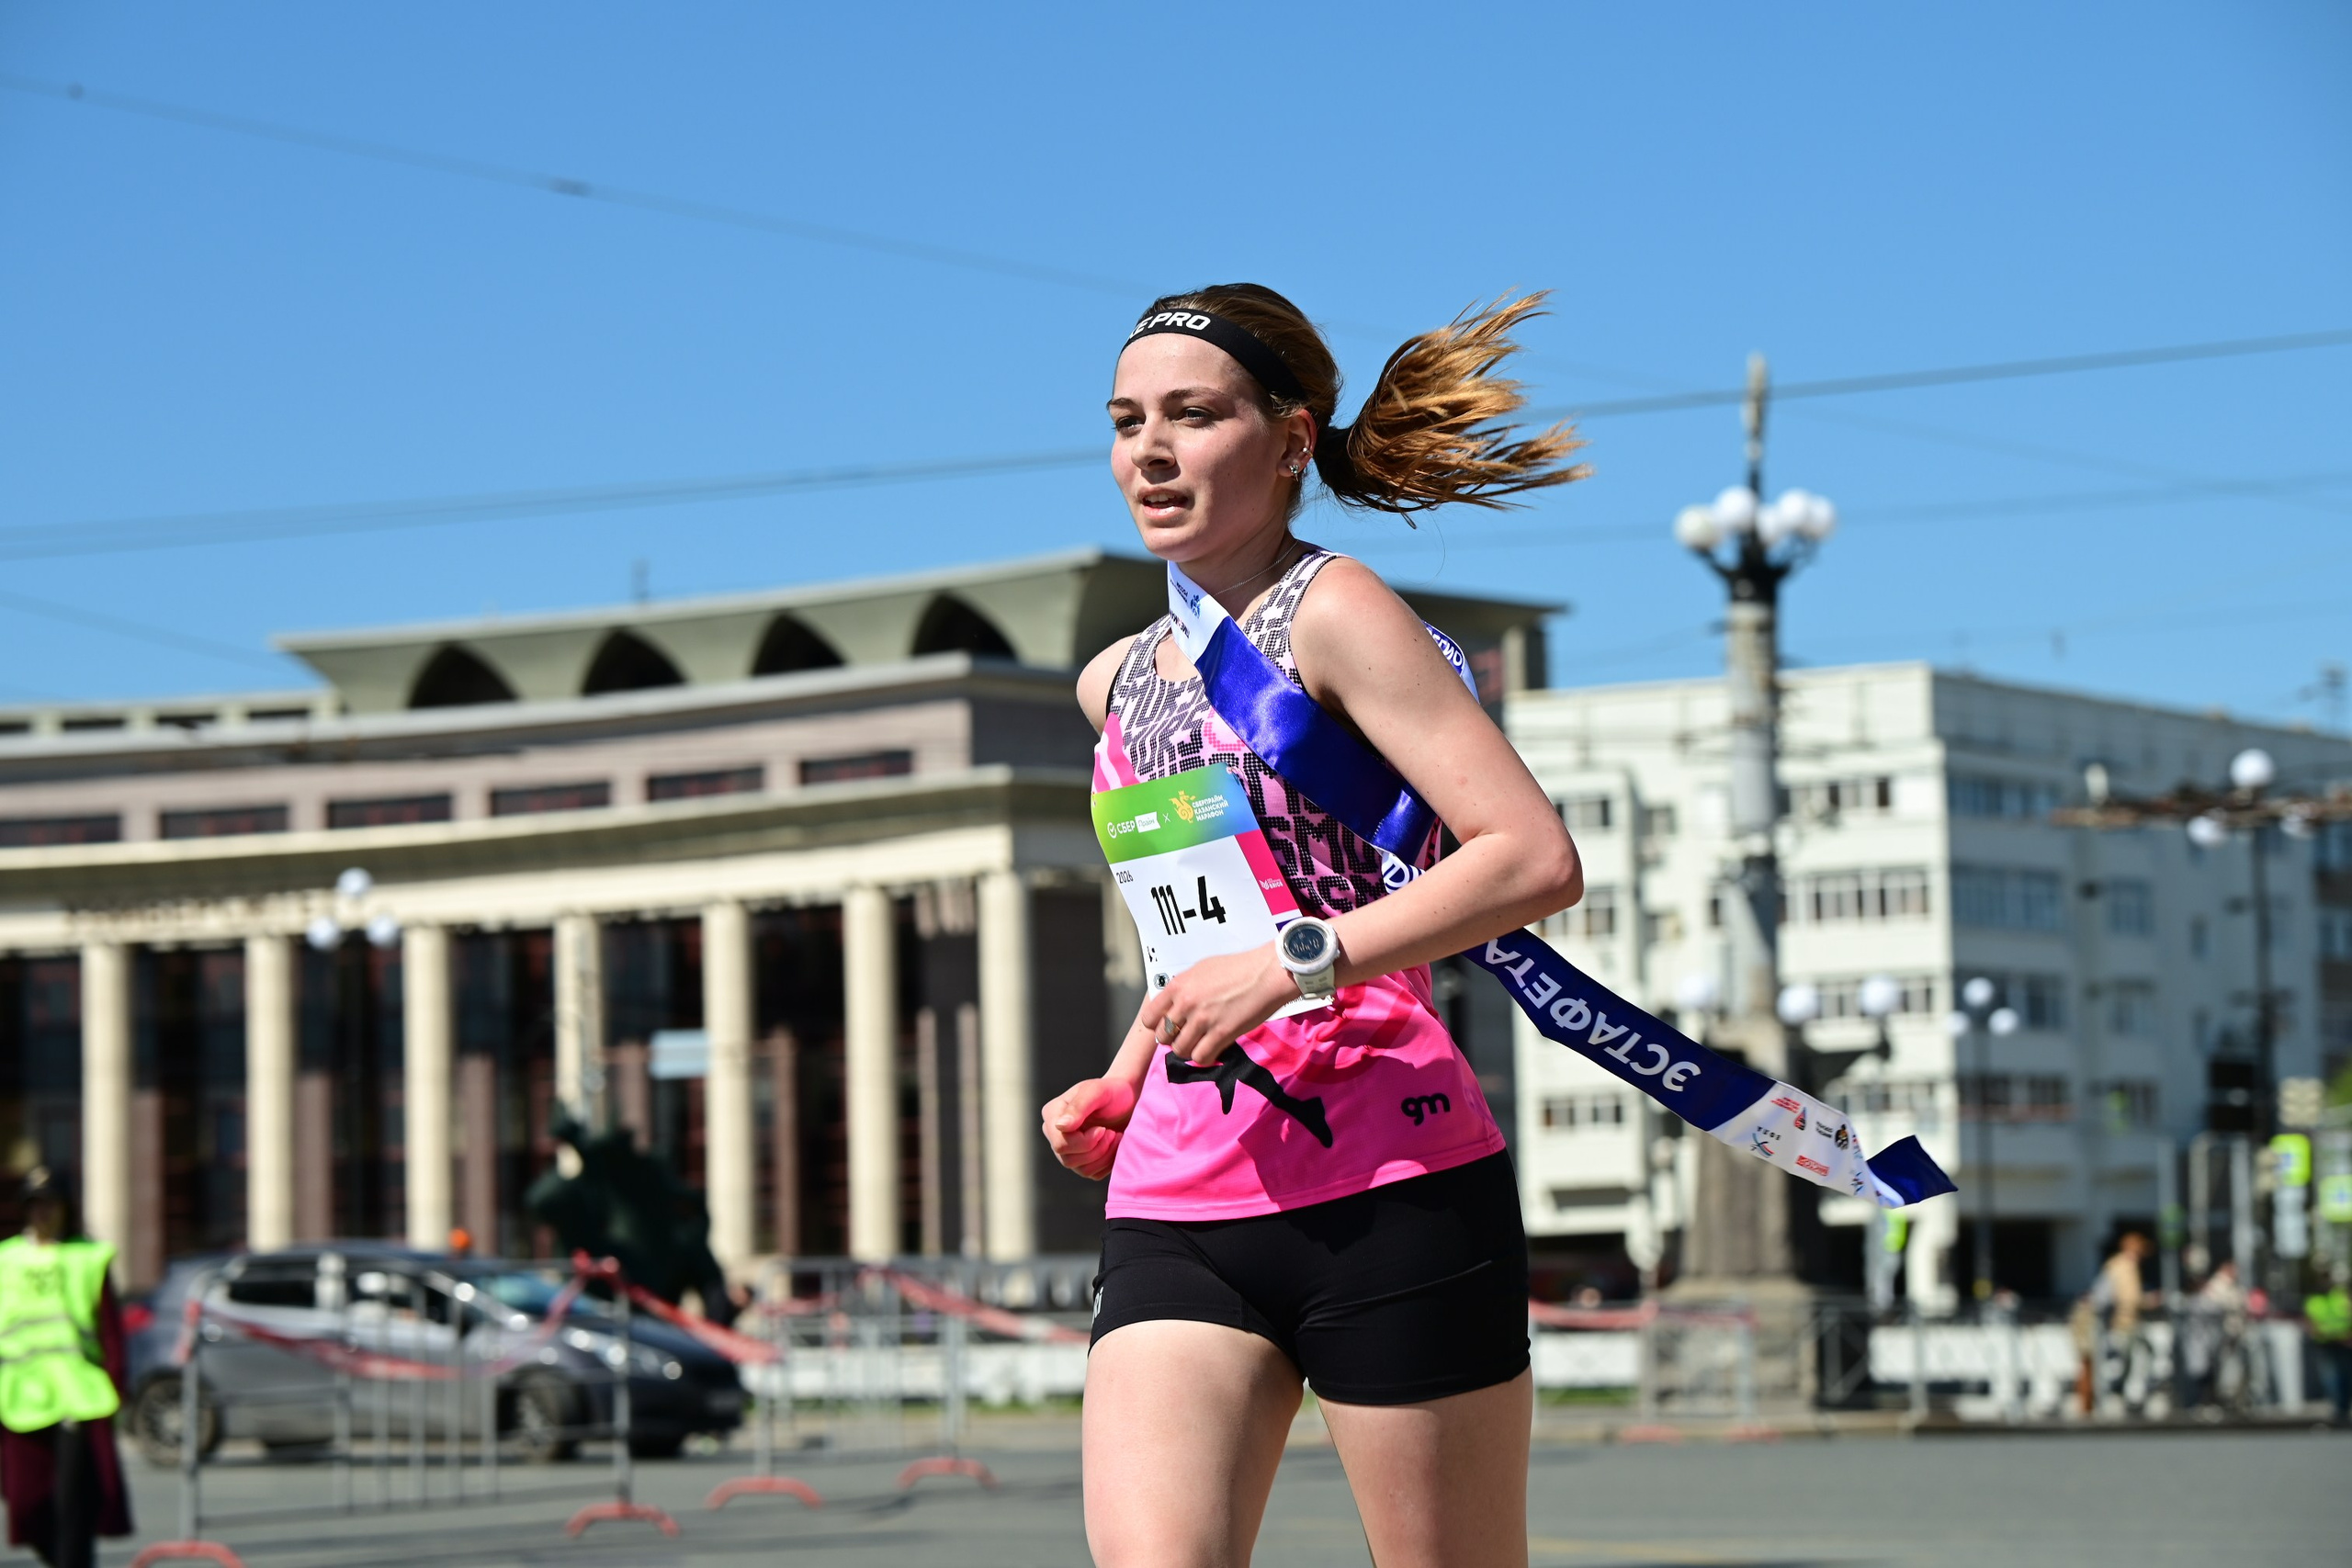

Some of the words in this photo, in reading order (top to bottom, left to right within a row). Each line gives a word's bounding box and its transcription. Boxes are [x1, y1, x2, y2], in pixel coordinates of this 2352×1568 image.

[1148, 311, 1211, 331] PRO
[1193, 799, 1229, 815] КАЗАНСКИЙ
[1196, 810, 1225, 822] МАРАФОН
[1116, 820, 1136, 835] СБЕР
[1116, 870, 1134, 884] 2026
[1150, 875, 1227, 935] 111-4
[1485, 937, 1702, 1092] ЭСТАФЕТА
